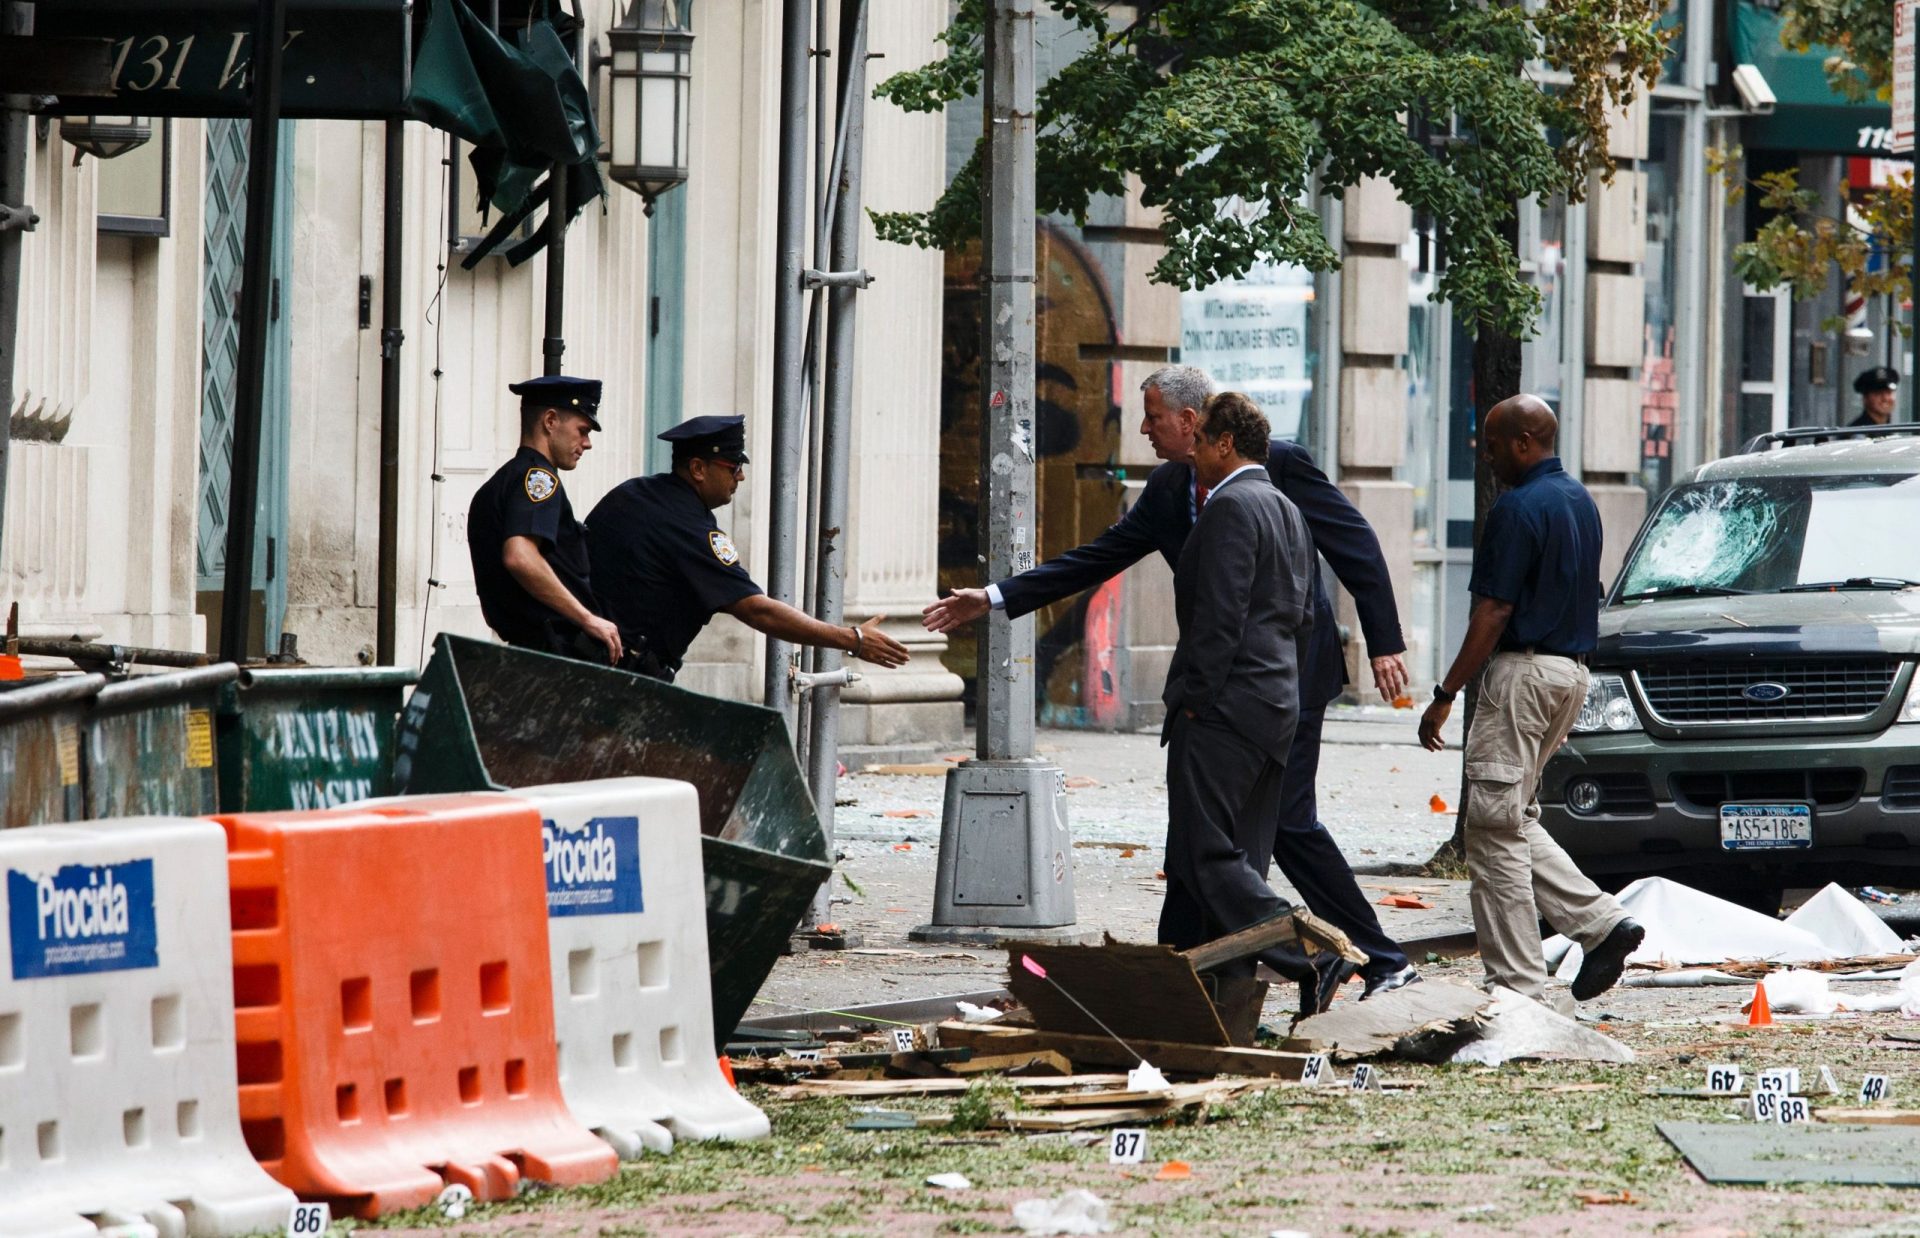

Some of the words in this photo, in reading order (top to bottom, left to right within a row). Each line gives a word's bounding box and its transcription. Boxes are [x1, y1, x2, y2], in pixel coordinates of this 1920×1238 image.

[110, 34, 195, 91] 131
[1743, 807, 1763, 816] NEW
[1765, 807, 1790, 816] YORK
[542, 824, 616, 884] Procida
[37, 868, 129, 940] Procida
[897, 1032, 912, 1050] 55
[1305, 1057, 1322, 1079] 54
[1353, 1066, 1368, 1089] 59
[1863, 1077, 1883, 1102] 48
[1781, 1100, 1804, 1123] 88
[1115, 1133, 1140, 1156] 87
[294, 1208, 320, 1233] 86
